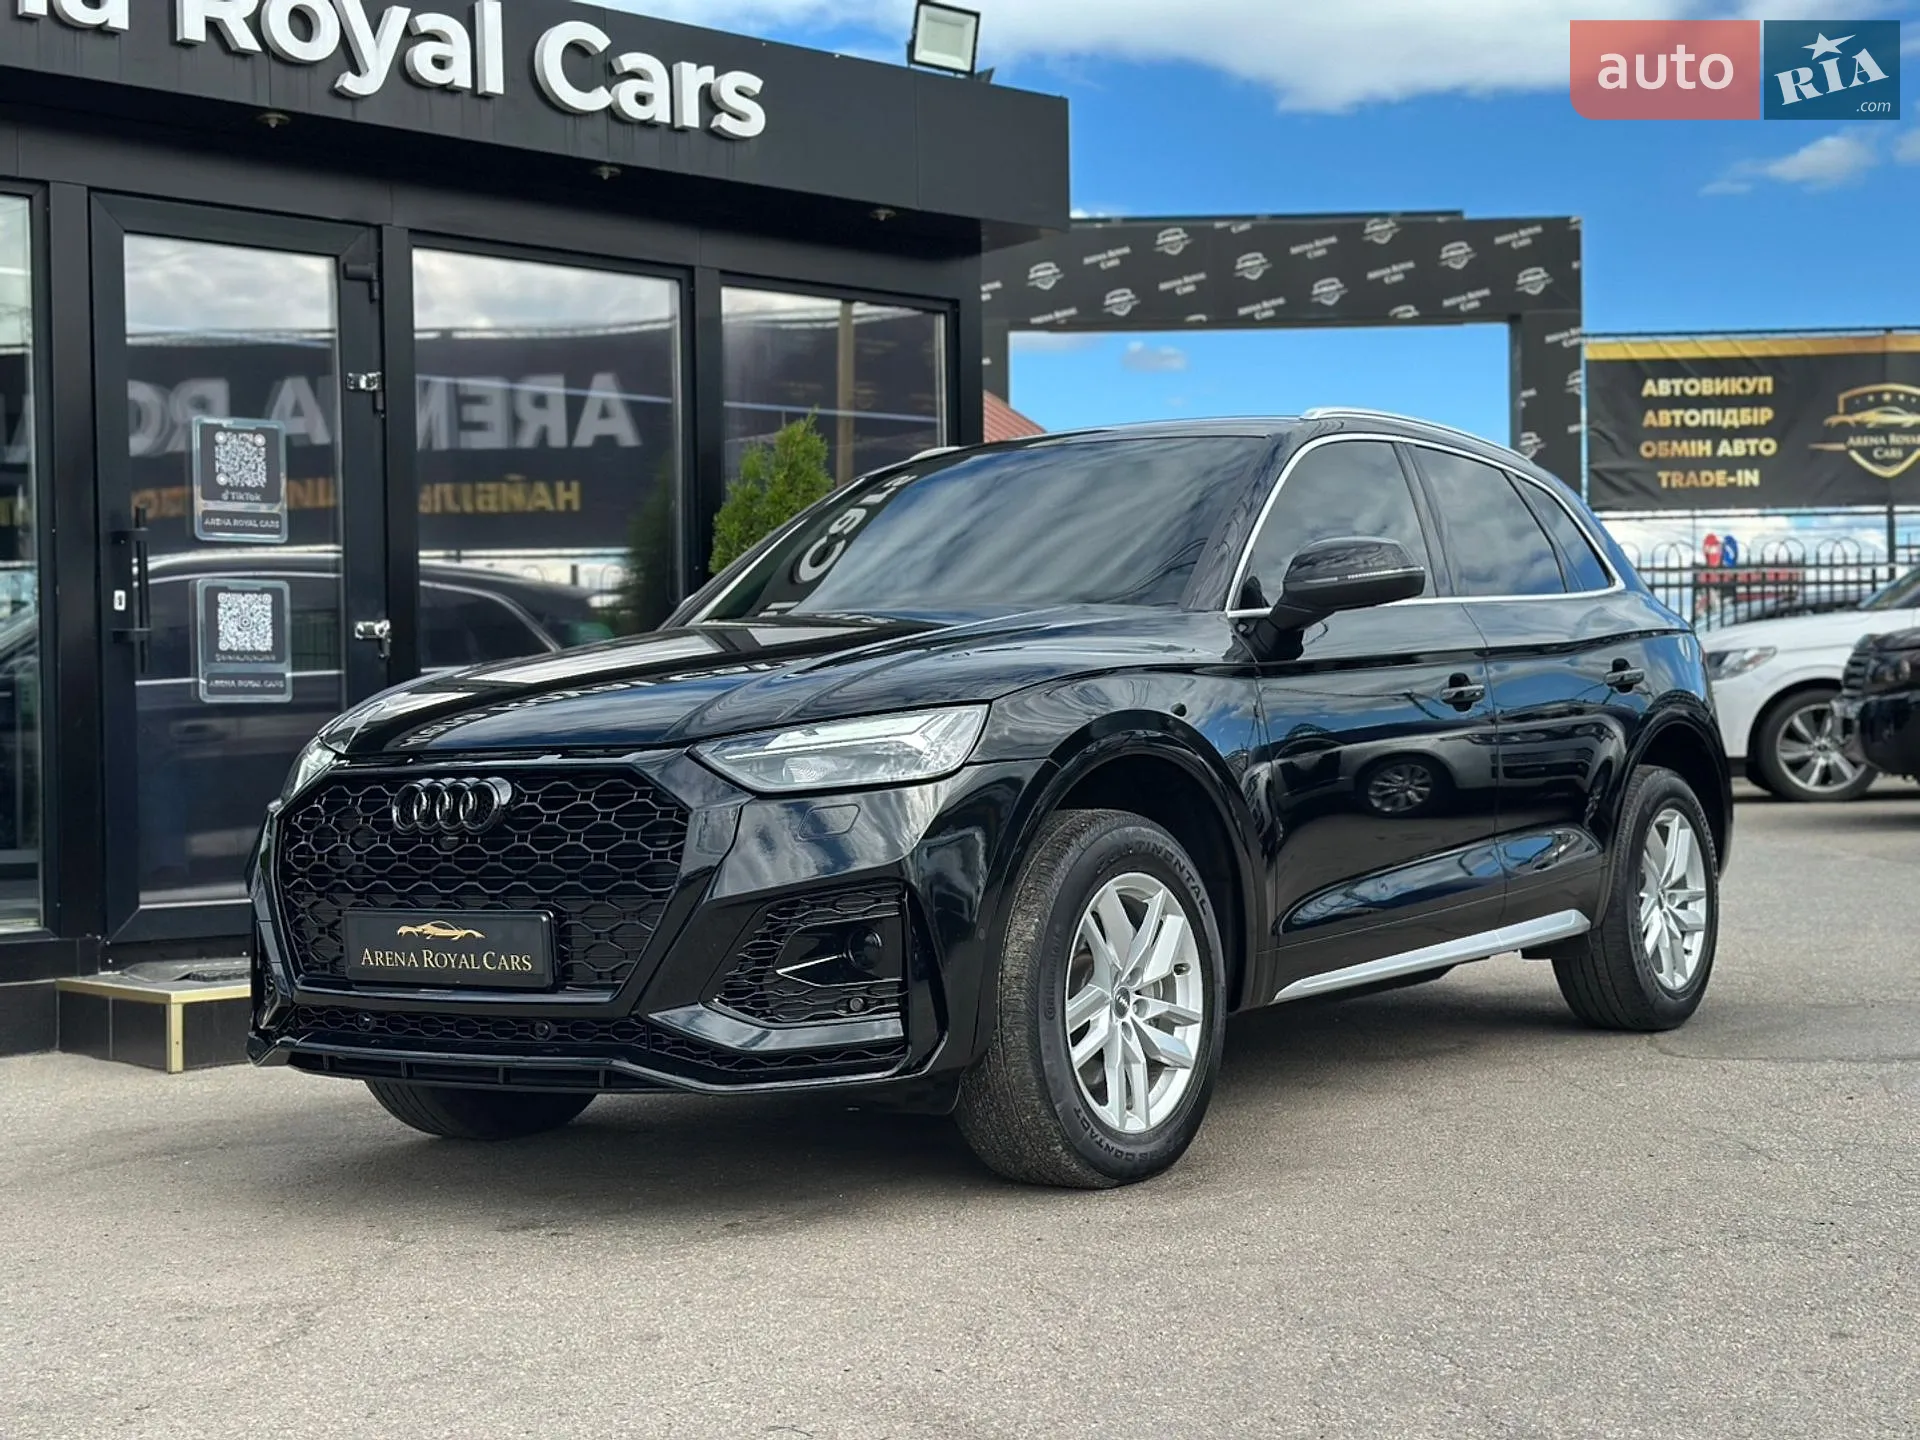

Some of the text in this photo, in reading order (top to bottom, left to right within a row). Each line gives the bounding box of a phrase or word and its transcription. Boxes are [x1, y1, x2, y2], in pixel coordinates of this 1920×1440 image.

[534, 19, 767, 140] Cars
[1641, 376, 1774, 398] АВТОВИКУП
[1642, 408, 1775, 429] АВТОПІДБІР
[1639, 435, 1778, 458] ОБМІН АВТО
[1657, 469, 1761, 489] TRADE-IN
[361, 948, 533, 972] ARENA ROYAL CARS
